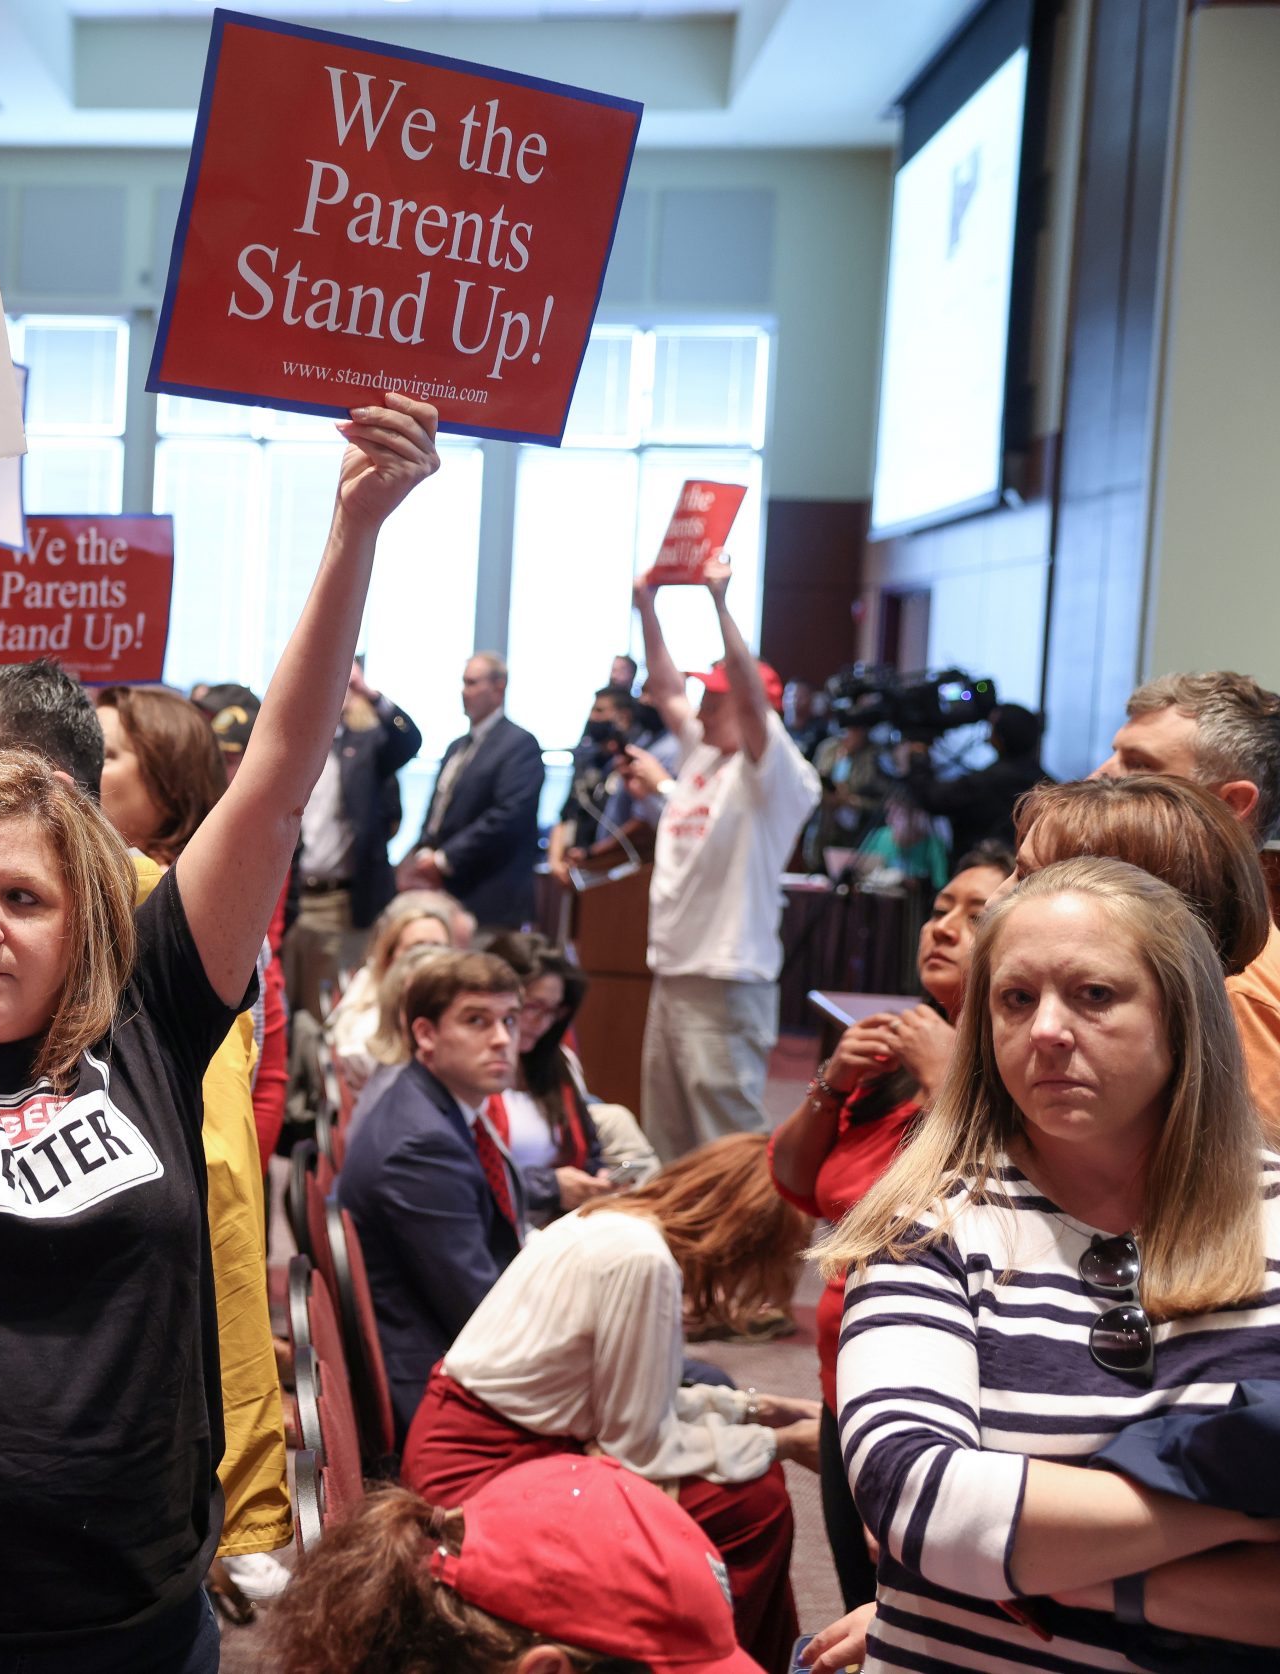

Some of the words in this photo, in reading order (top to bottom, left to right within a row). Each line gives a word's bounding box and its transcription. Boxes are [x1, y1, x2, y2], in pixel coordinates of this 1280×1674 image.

[324, 65, 437, 161] We
[459, 99, 548, 184] the
[293, 158, 534, 273] Parents
[228, 243, 431, 345] Stand
[452, 278, 555, 380] Up!
[281, 359, 489, 404] www.standupvirginia.com
[12, 527, 68, 566] We
[76, 526, 128, 565] the
[0, 571, 128, 609] Parents
[84, 612, 147, 661] Up!
[1, 1109, 134, 1206] FLTER
